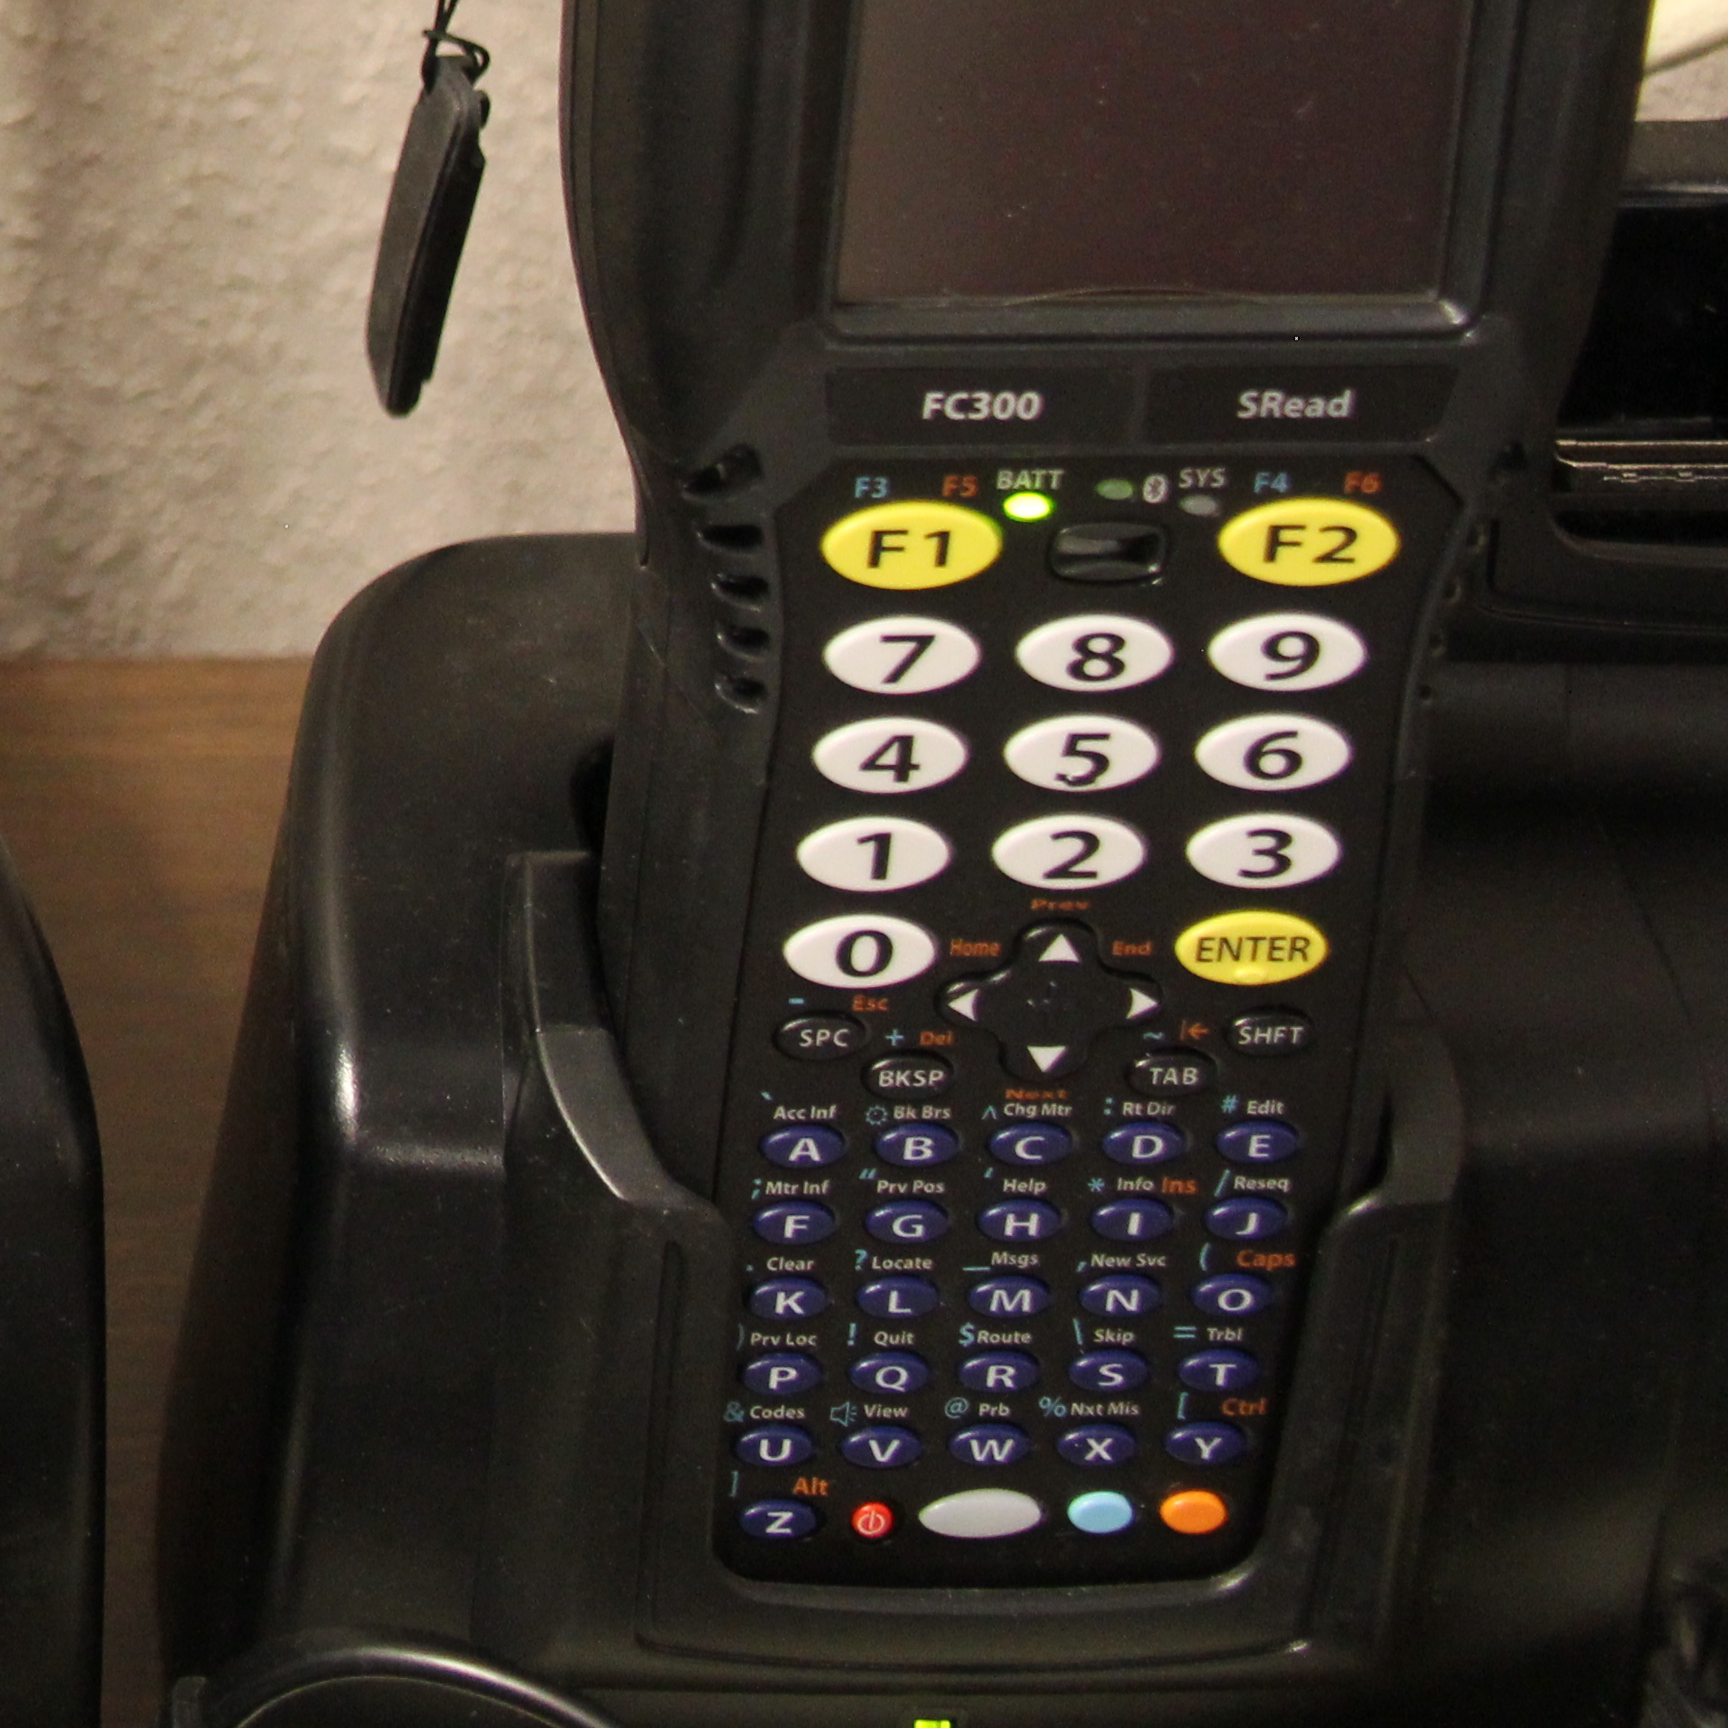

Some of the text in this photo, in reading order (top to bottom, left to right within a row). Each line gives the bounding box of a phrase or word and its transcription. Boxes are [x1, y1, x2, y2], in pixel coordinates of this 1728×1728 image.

[923, 391, 1041, 420] FC300
[1238, 389, 1352, 419] SRead
[854, 477, 888, 499] F3
[997, 470, 1061, 490] BATT
[1179, 468, 1225, 488] SYS
[1254, 472, 1289, 493] F4
[867, 529, 951, 569] F1
[1263, 524, 1358, 564] F2
[880, 634, 936, 684] 7
[1066, 632, 1126, 683] 8
[1261, 630, 1321, 681] 9
[859, 734, 921, 783] 4
[1055, 732, 1111, 788] 5
[1243, 730, 1303, 781] 6
[857, 832, 892, 881] 1
[1043, 829, 1101, 880] 2
[1238, 828, 1293, 880] 3
[835, 929, 894, 978] 0
[950, 939, 1000, 957] Home
[1112, 941, 1152, 956] End
[1195, 935, 1311, 963] ENTER
[800, 1028, 849, 1048] SPC
[1238, 1024, 1303, 1045] SHFT
[878, 1070, 944, 1088] BKSP
[1150, 1067, 1198, 1085] TAB
[1003, 1178, 1047, 1195] Help
[1234, 1175, 1290, 1193] Reseq
[976, 1329, 1032, 1344] Route
[863, 1404, 908, 1418] View
[793, 1477, 828, 1496] Alt
